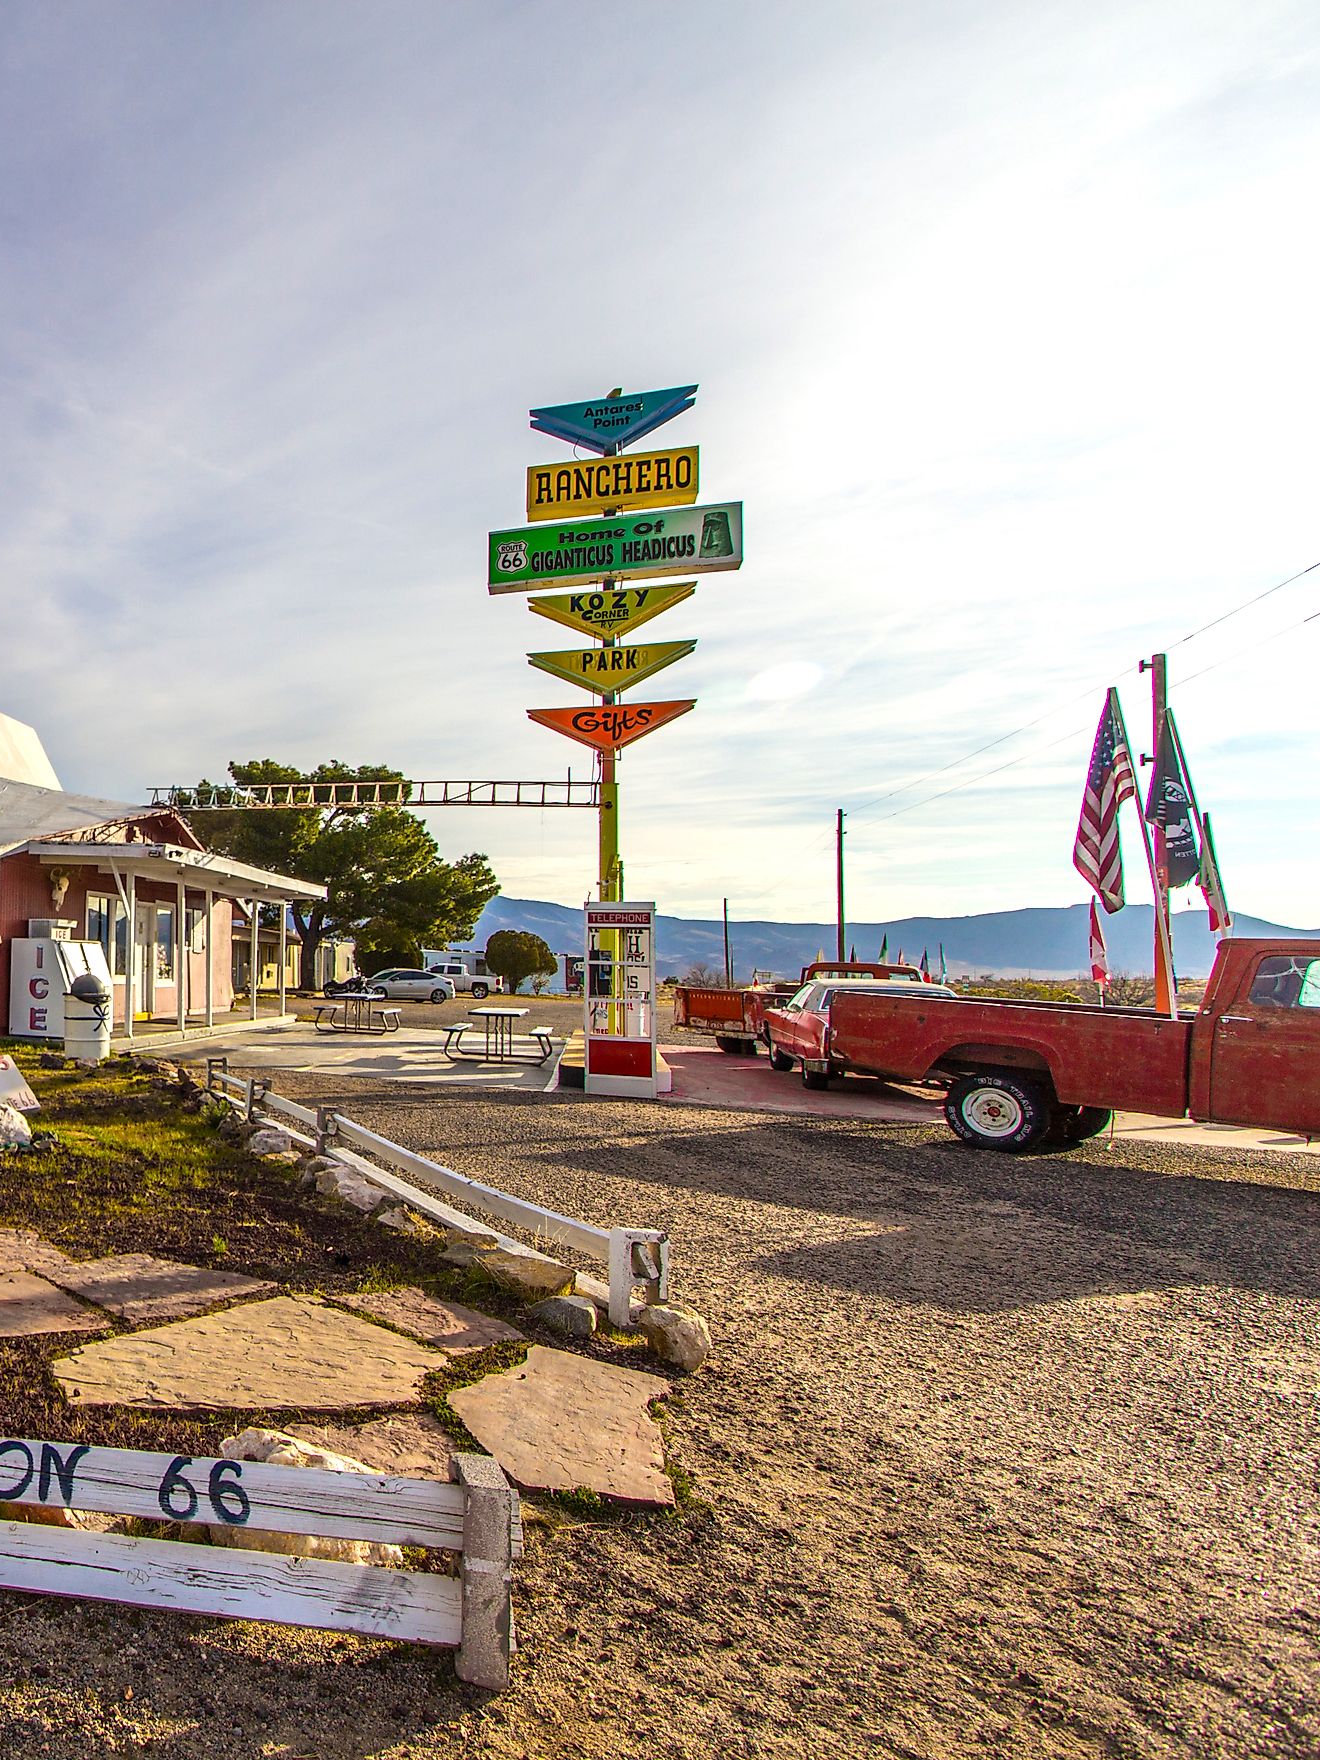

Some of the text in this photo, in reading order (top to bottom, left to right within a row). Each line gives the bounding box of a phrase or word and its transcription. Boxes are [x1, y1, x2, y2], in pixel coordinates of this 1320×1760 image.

[583, 402, 641, 418] Antares
[593, 416, 631, 428] Point
[535, 455, 691, 504] RANCHERO
[558, 519, 665, 544] Home Of
[500, 544, 523, 552] ROUTE
[531, 534, 695, 573] GIGANTICUS HEADICUS
[501, 553, 523, 569] 66
[569, 589, 649, 613] KOZY
[581, 608, 630, 622] CORNER
[582, 649, 638, 672] PARK
[571, 708, 653, 741] Gifts
[590, 913, 649, 923] TELEPHONE
[55, 930, 67, 939] ICE
[29, 944, 49, 1031] ICE
[18, 1091, 36, 1107] 66
[158, 1455, 252, 1525] 66
